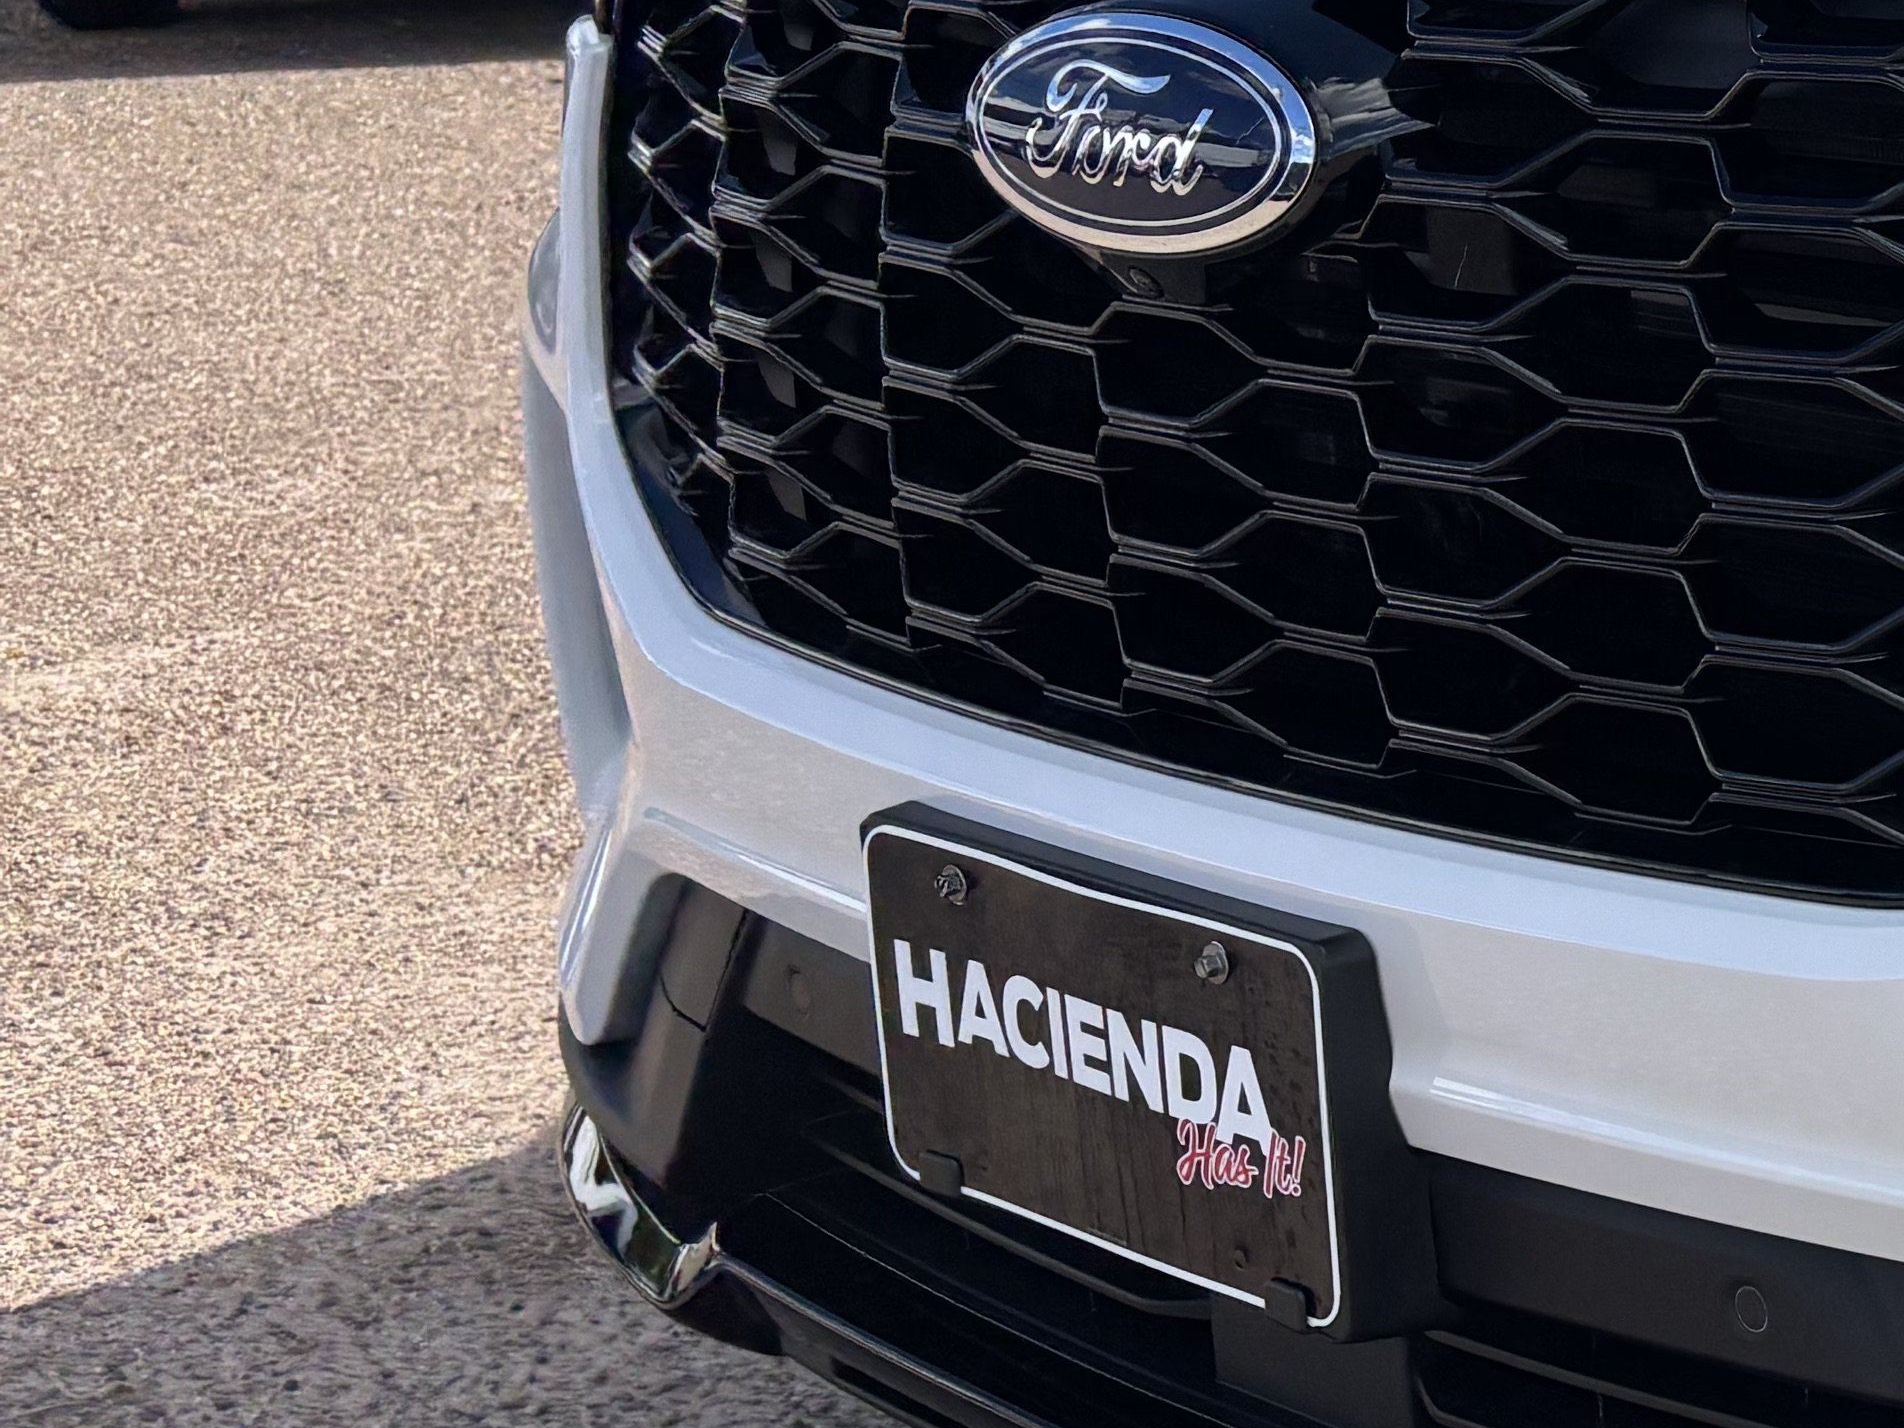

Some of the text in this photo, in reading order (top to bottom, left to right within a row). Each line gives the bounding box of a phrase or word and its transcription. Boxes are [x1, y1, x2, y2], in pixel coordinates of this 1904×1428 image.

[1024, 59, 1204, 196] Ford
[893, 939, 1273, 1157] HACIENDA
[1177, 1118, 1306, 1198] Has It!
